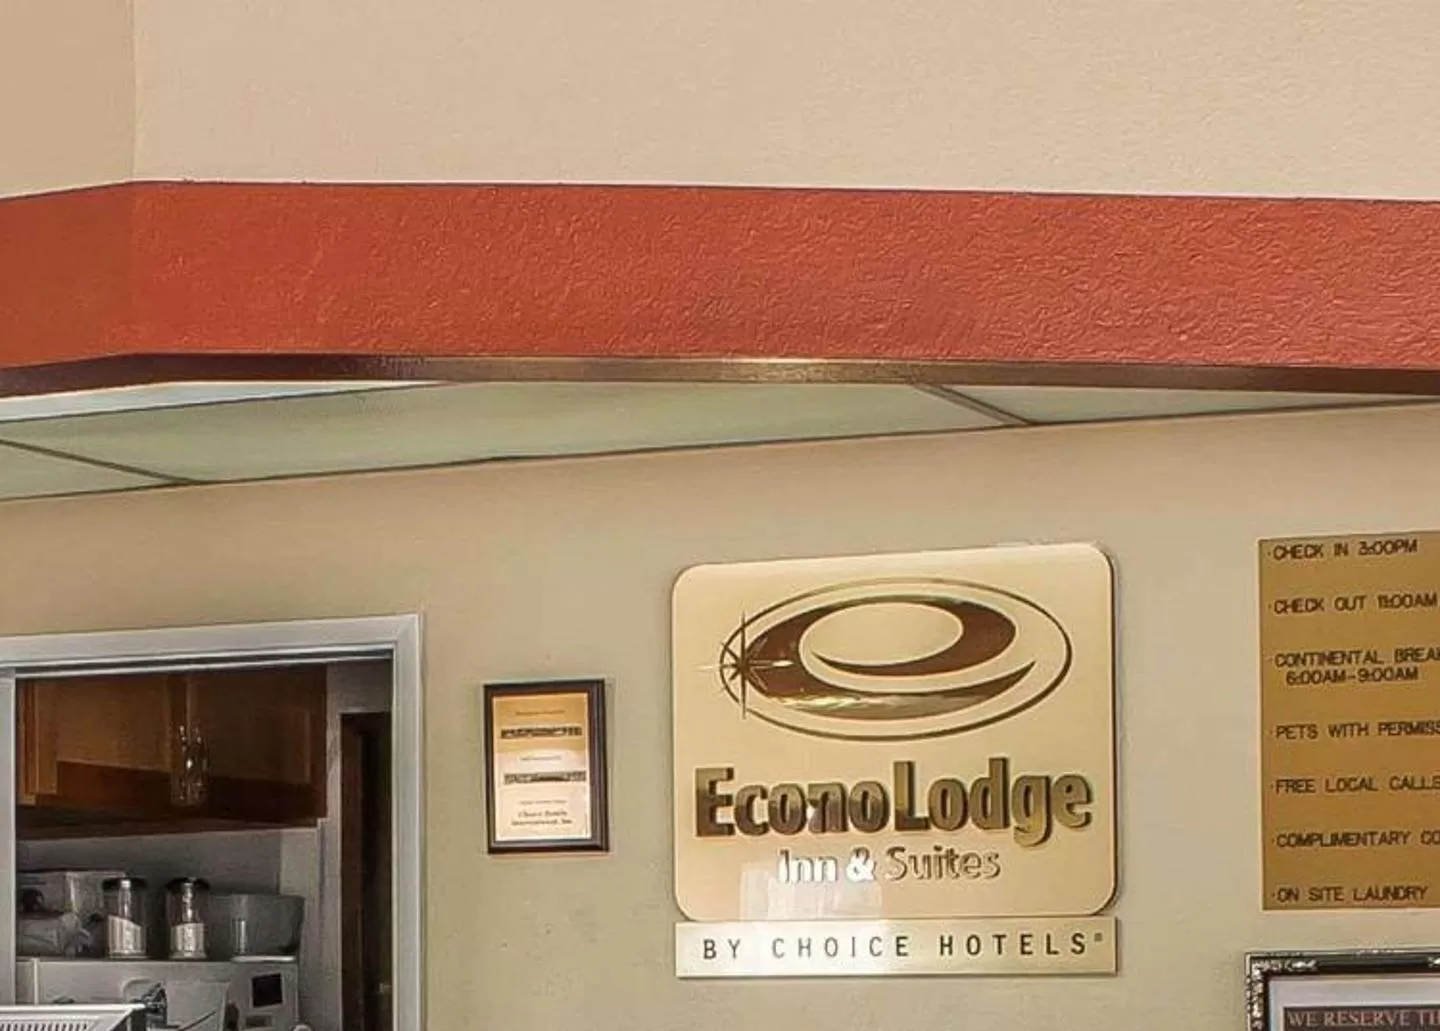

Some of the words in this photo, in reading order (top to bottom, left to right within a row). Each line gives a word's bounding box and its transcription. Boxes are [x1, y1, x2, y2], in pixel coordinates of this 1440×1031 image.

[1273, 544, 1324, 560] CHECK
[1334, 542, 1348, 556] IN
[1358, 539, 1418, 556] 3:00PM
[1274, 598, 1325, 615] CHECK
[1334, 595, 1367, 612] OUT
[1378, 592, 1438, 609] 11:00AM
[1274, 650, 1384, 668] CONTINENTAL
[1275, 724, 1318, 740] PETS
[1328, 723, 1368, 738] WITH
[1275, 778, 1315, 794] FREE
[1325, 776, 1378, 793] LOCAL
[694, 757, 1093, 847] EconoLodge
[1276, 831, 1410, 849] COMPLIMENTARY
[778, 849, 837, 884] Inn
[846, 846, 876, 882] &
[885, 845, 1001, 881] Suites
[1277, 888, 1298, 903] ON
[1309, 886, 1345, 901] SITE
[1353, 885, 1429, 901] LAUNDRY
[703, 938, 742, 960] BY
[772, 935, 910, 959] CHOICE
[1287, 1012, 1319, 1027] WE
[1324, 1010, 1411, 1027] RESERVE
